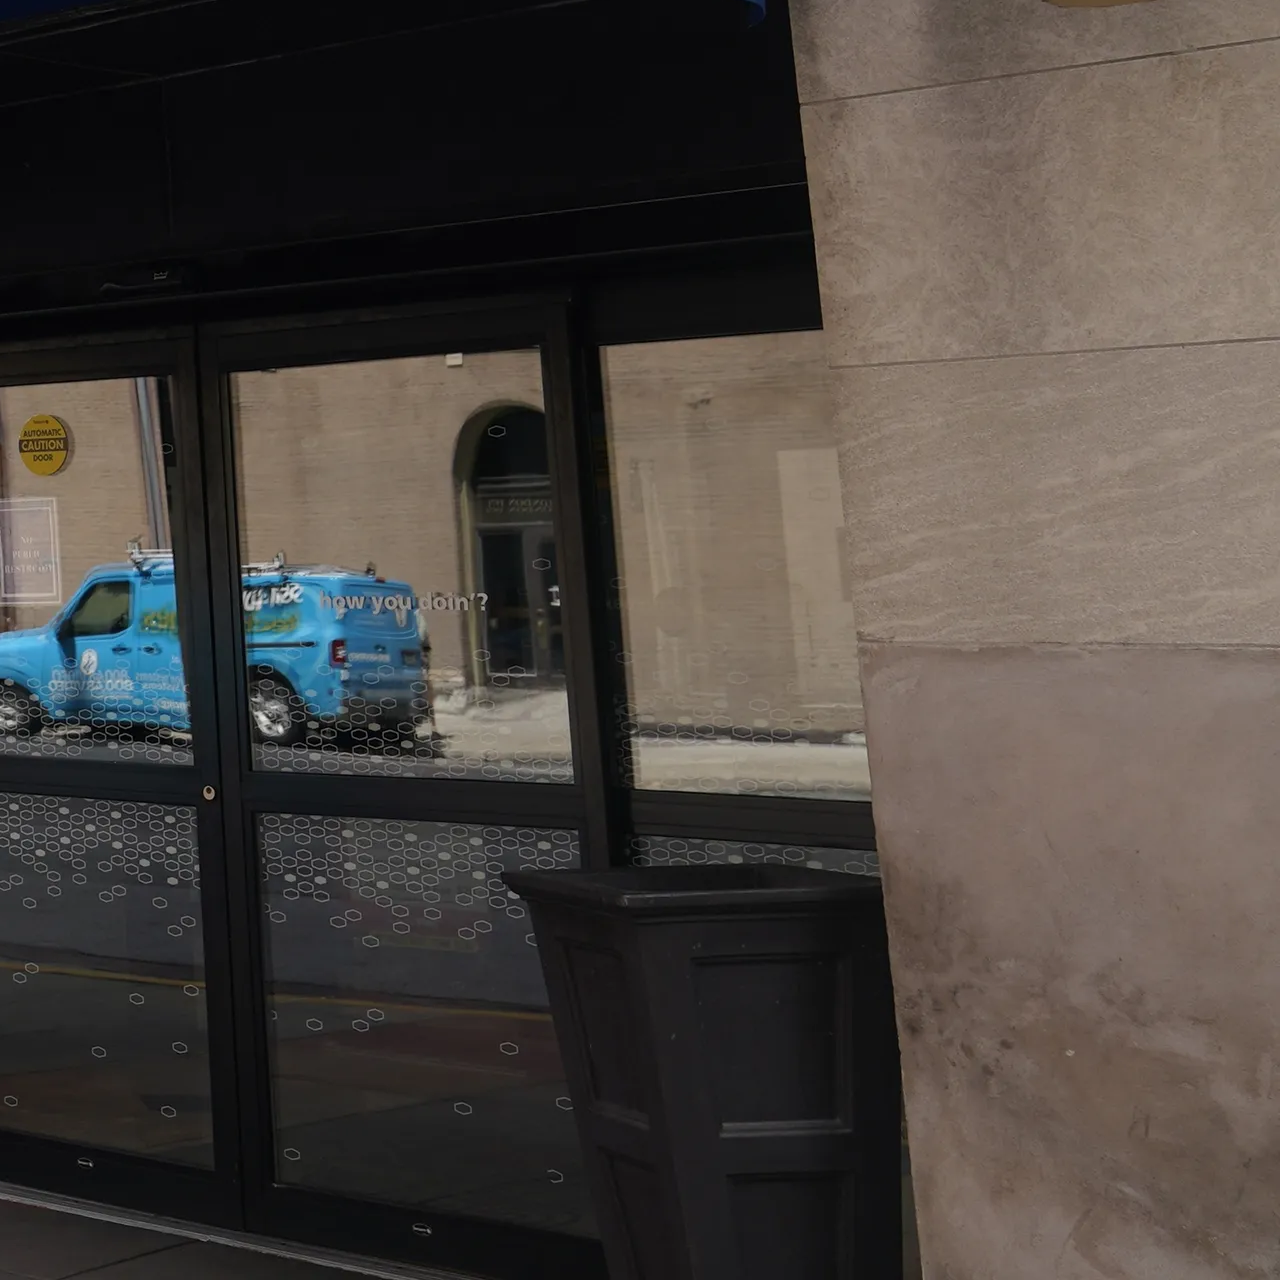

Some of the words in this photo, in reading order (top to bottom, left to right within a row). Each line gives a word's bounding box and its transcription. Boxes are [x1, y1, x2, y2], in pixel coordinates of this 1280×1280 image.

[23, 428, 62, 438] AUTOMATIC
[22, 439, 64, 451] CAUTION
[33, 454, 53, 462] DOOR
[320, 590, 366, 610] how
[371, 594, 412, 615] you
